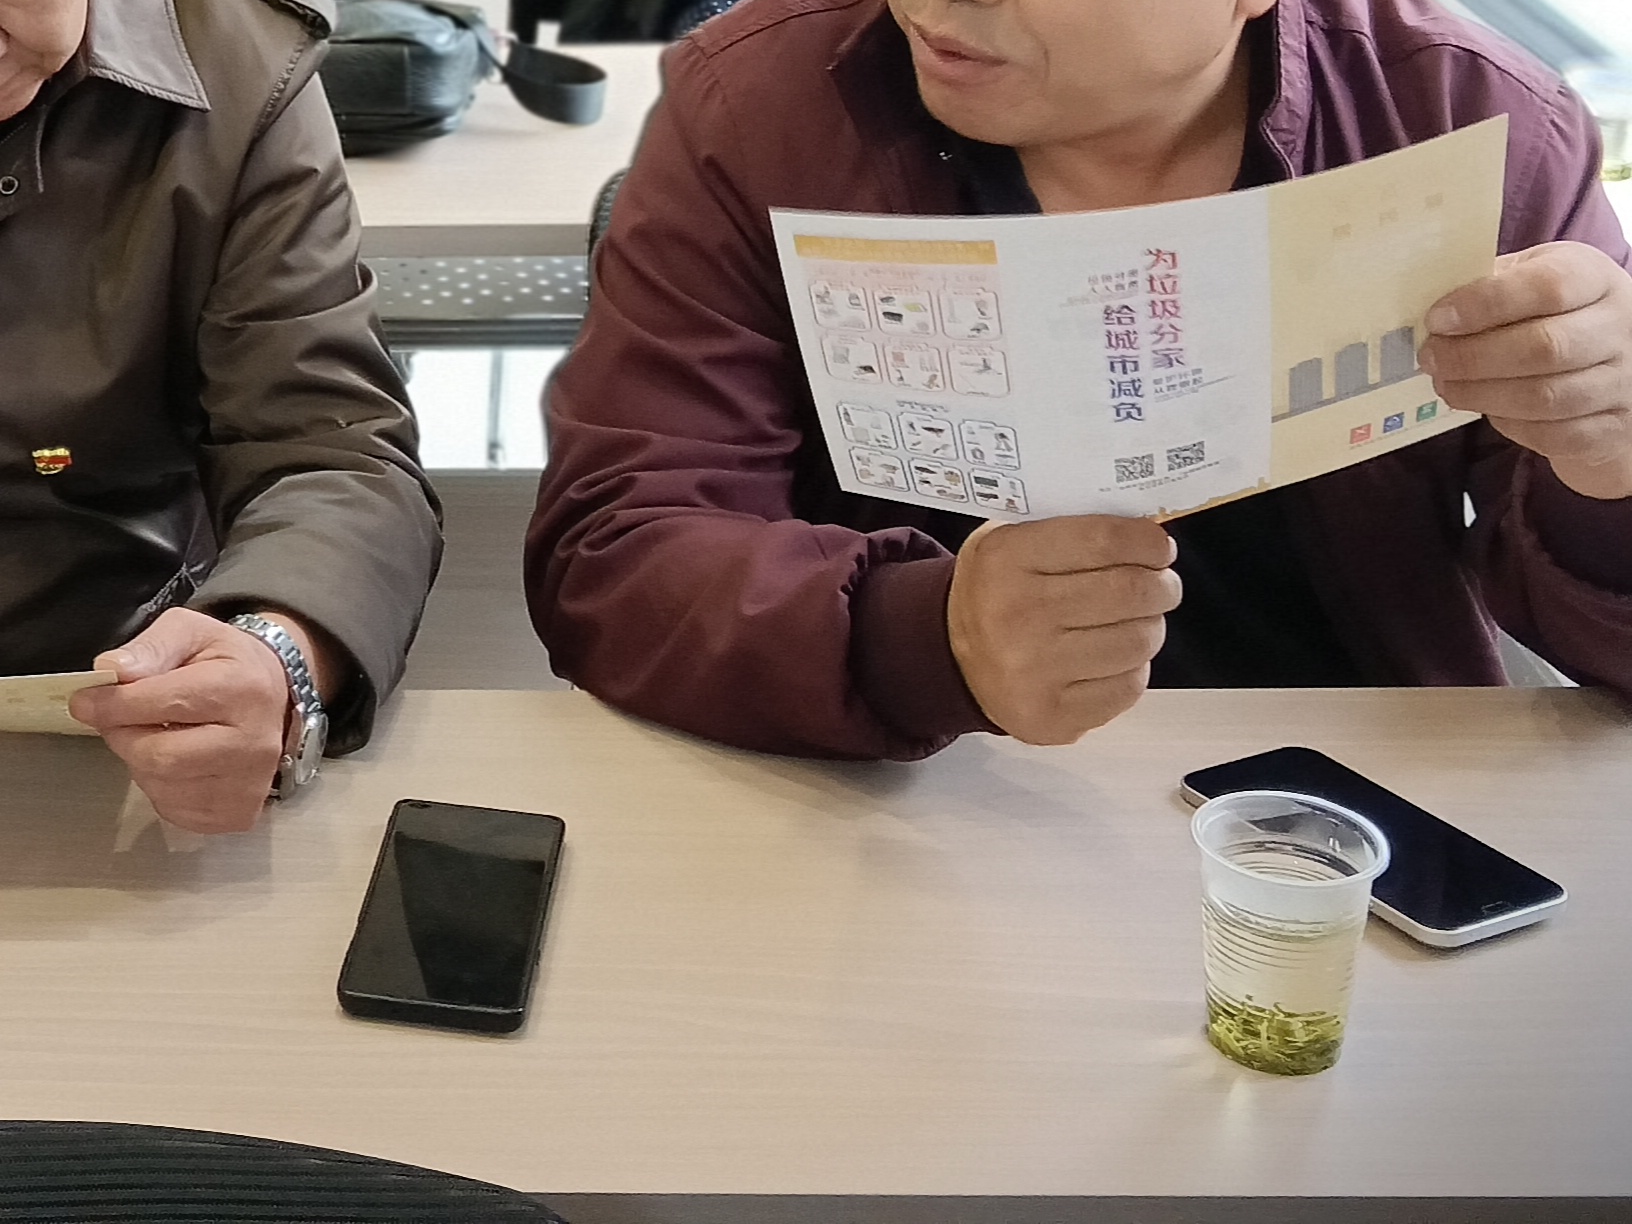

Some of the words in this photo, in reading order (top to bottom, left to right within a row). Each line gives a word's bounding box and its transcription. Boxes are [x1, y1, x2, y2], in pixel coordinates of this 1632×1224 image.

[1103, 304, 1145, 423] 给城市减负
[1143, 248, 1185, 370] 为垃圾分家
